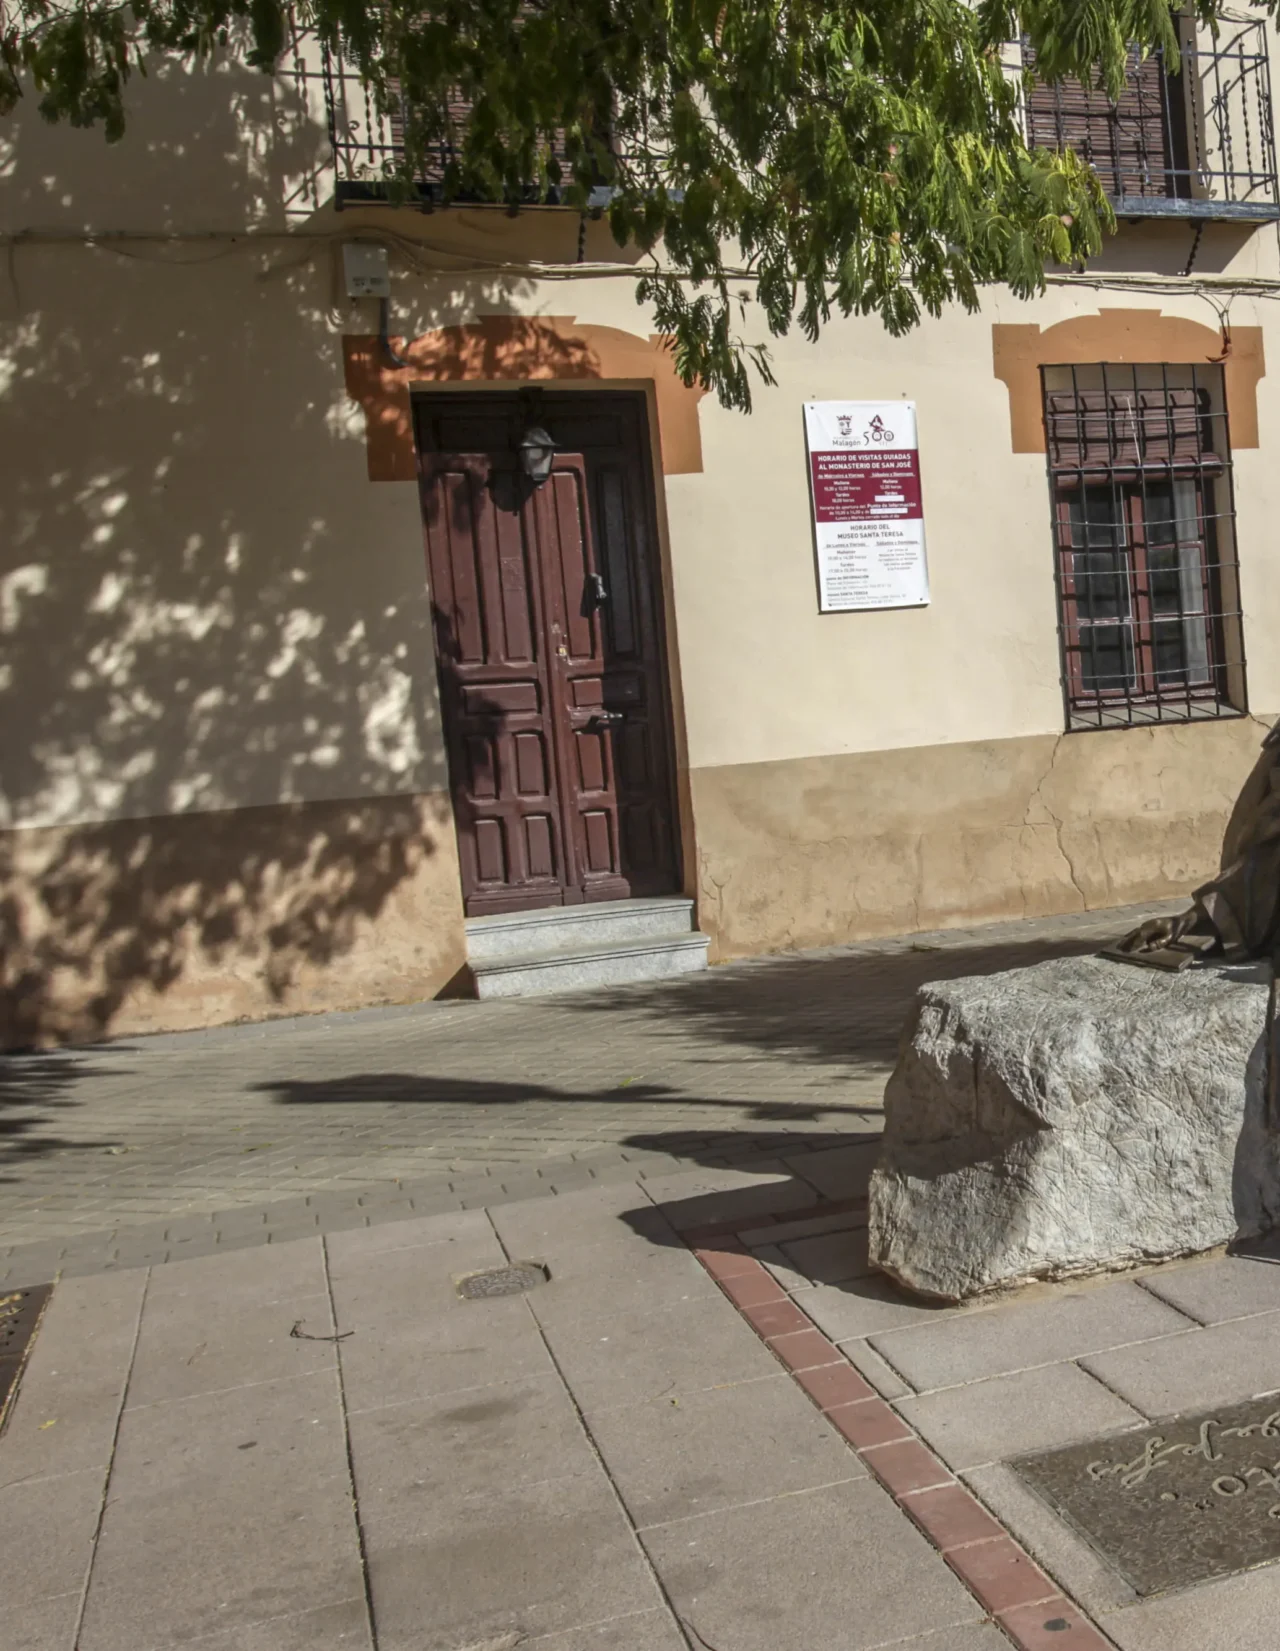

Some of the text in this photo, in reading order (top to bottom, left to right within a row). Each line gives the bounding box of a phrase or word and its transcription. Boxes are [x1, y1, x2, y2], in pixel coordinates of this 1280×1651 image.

[832, 439, 861, 447] Malagón
[829, 462, 870, 470] MONASTERIO
[896, 460, 912, 468] JOSÉ
